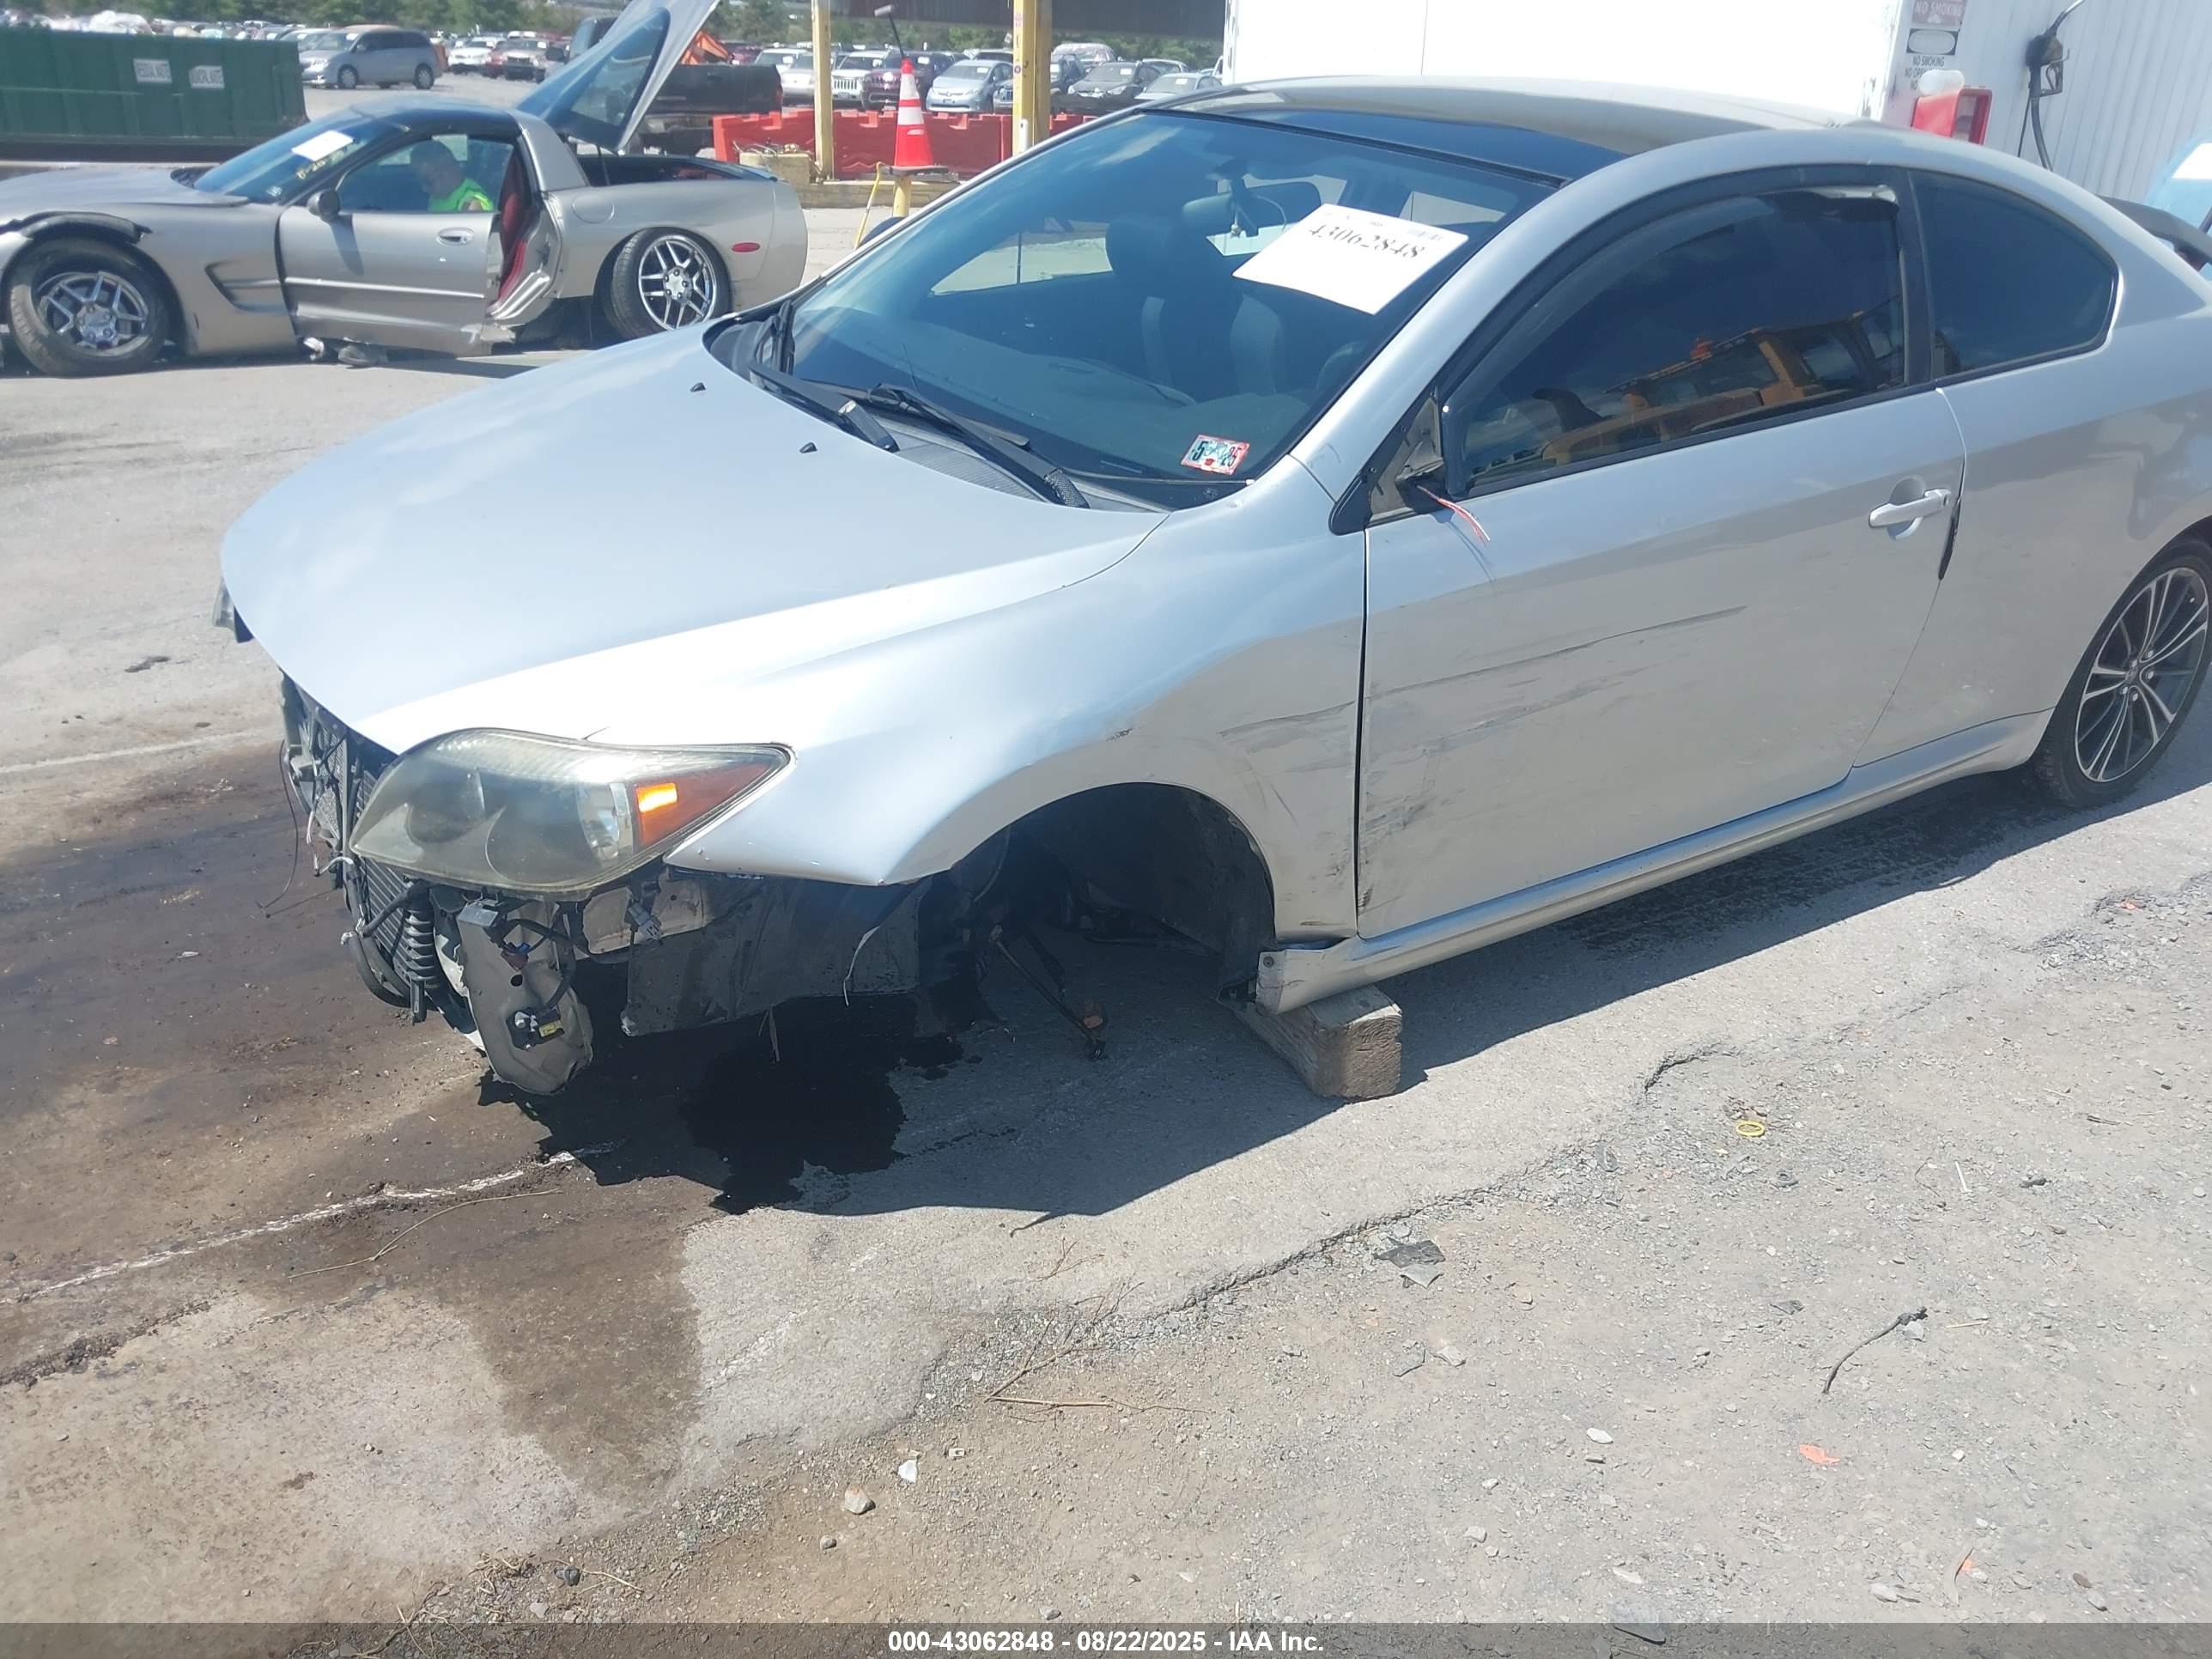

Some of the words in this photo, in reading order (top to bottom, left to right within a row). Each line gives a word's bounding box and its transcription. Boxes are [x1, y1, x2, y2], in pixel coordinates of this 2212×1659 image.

[1915, 1, 1928, 15] NO
[1929, 2, 1963, 17] SMOKING
[1912, 56, 1921, 66] NO
[1922, 57, 1945, 67] SMOKING
[1905, 68, 1913, 77] NO
[1910, 79, 1918, 90] NO
[1309, 224, 1425, 258] 43062848
